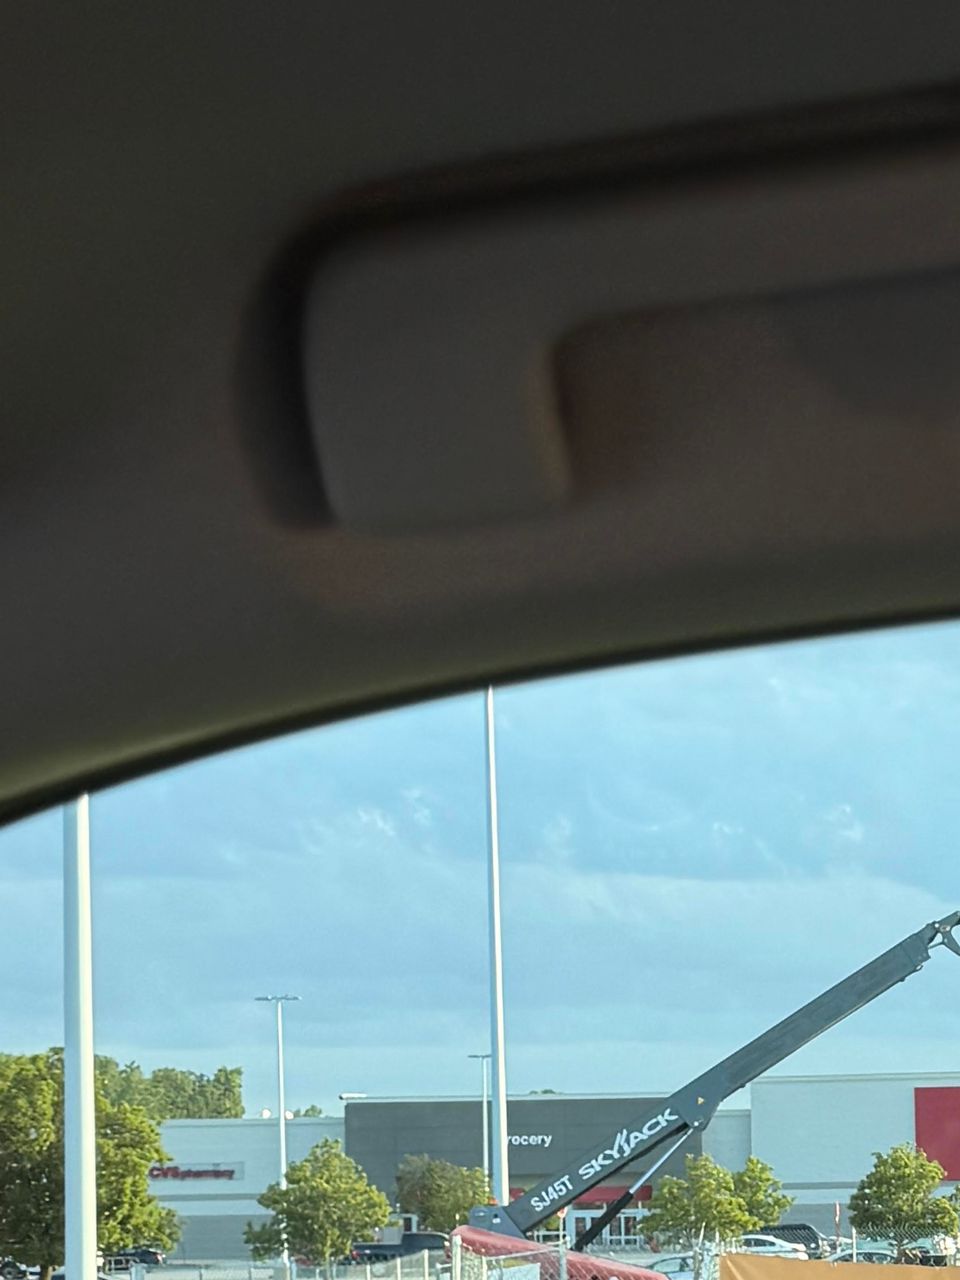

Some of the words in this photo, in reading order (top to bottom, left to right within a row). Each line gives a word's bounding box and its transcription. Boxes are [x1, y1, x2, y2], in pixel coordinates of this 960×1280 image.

[505, 1134, 552, 1148] rocery
[531, 1174, 575, 1212] SJ45T
[578, 1107, 679, 1181] SKYJACK
